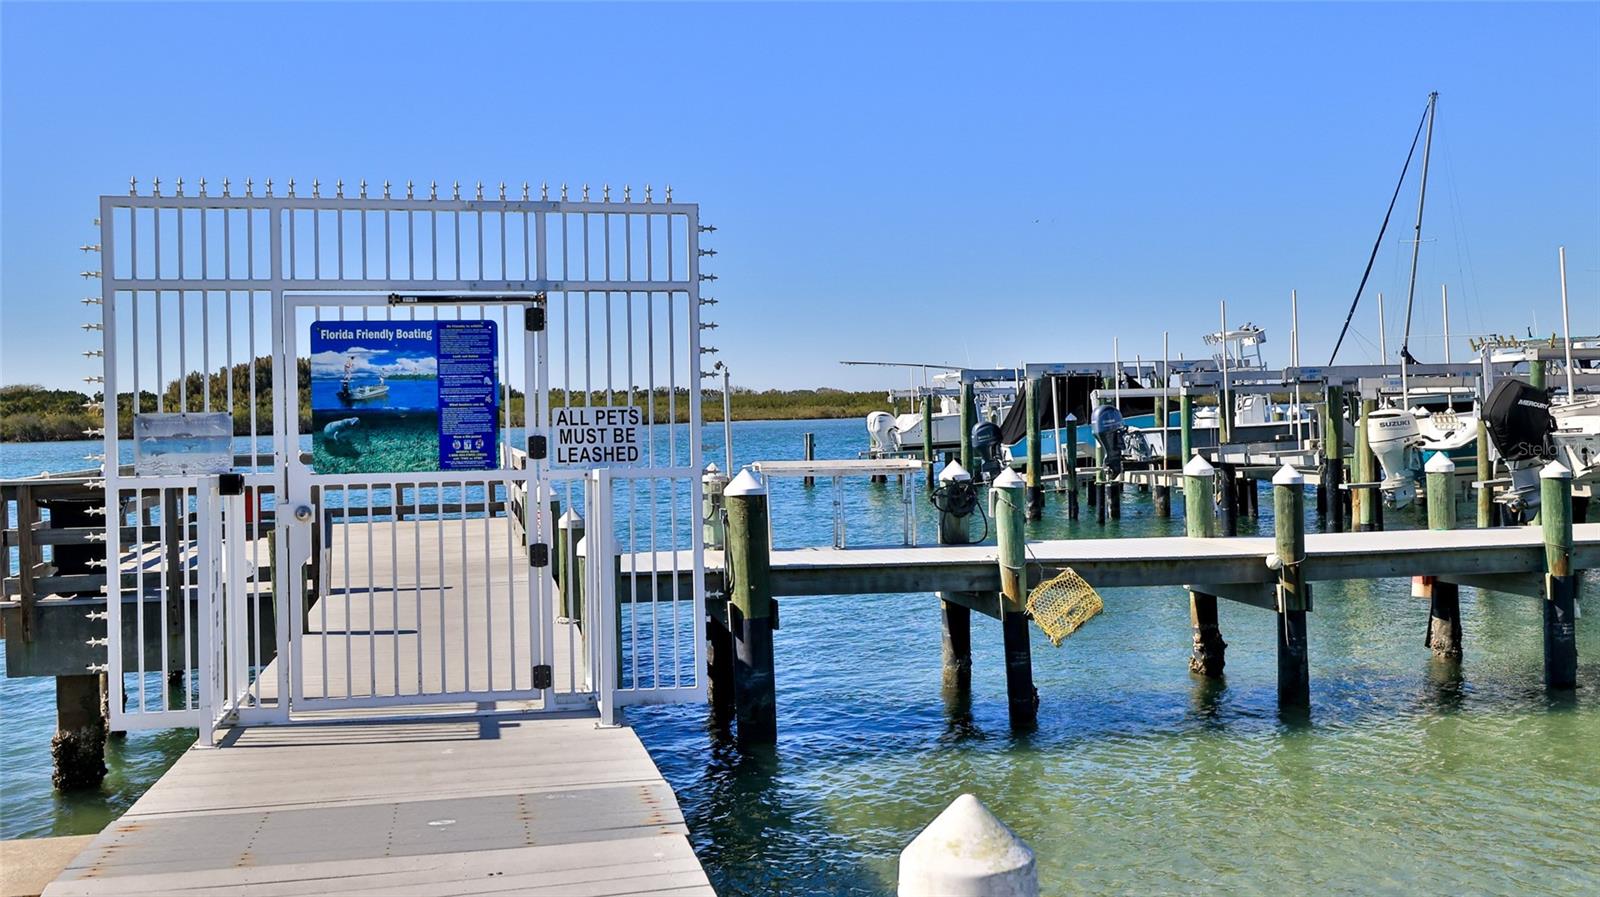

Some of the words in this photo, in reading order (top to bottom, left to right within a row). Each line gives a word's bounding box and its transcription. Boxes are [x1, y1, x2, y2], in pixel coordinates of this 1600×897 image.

[320, 329, 354, 340] Florida
[356, 328, 394, 341] Friendly
[396, 328, 433, 341] Boating
[1517, 398, 1549, 410] MERCURY
[556, 410, 589, 426] ALL
[595, 409, 638, 426] PETS
[1379, 419, 1410, 428] SUZUKI
[559, 428, 607, 445] MUST
[613, 428, 636, 444] BE
[557, 446, 639, 463] LEASHED
